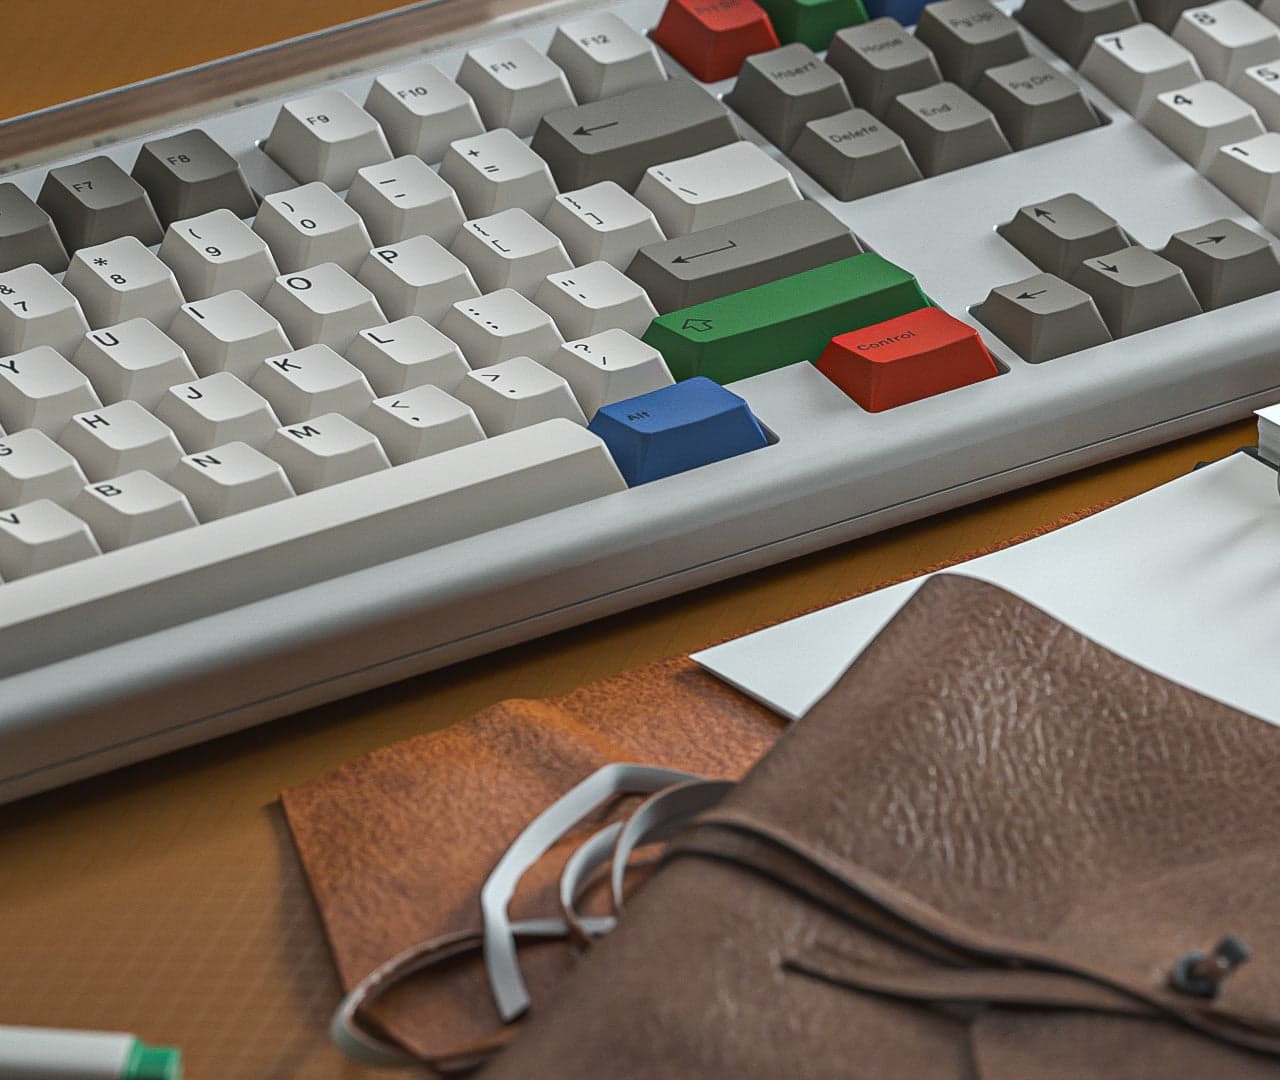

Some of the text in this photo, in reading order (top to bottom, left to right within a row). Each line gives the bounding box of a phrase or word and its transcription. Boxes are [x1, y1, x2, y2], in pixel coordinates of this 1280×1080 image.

[1192, 11, 1217, 27] 8
[579, 33, 611, 49] F12
[1104, 36, 1127, 52] 7
[489, 59, 519, 75] F11
[769, 61, 816, 81] Insert
[1255, 67, 1280, 83] 5
[397, 85, 429, 100] F10
[1172, 93, 1194, 108] 4
[920, 103, 952, 118] End
[305, 113, 331, 127] F9
[827, 124, 879, 144] Delete
[166, 152, 193, 167] F8
[1230, 145, 1250, 158] 1
[71, 180, 96, 194] F7
[204, 245, 223, 258] 9
[376, 249, 400, 264] P
[109, 273, 128, 286] 8
[285, 275, 314, 292] O
[12, 300, 31, 313] 7
[92, 330, 121, 348] U
[366, 332, 396, 346] L
[855, 329, 918, 352] Control
[272, 356, 303, 373] K
[185, 384, 203, 402] J
[80, 413, 111, 430] H
[625, 409, 652, 423] Alt
[286, 423, 322, 441] M
[191, 453, 223, 469] N
[92, 484, 123, 498] B
